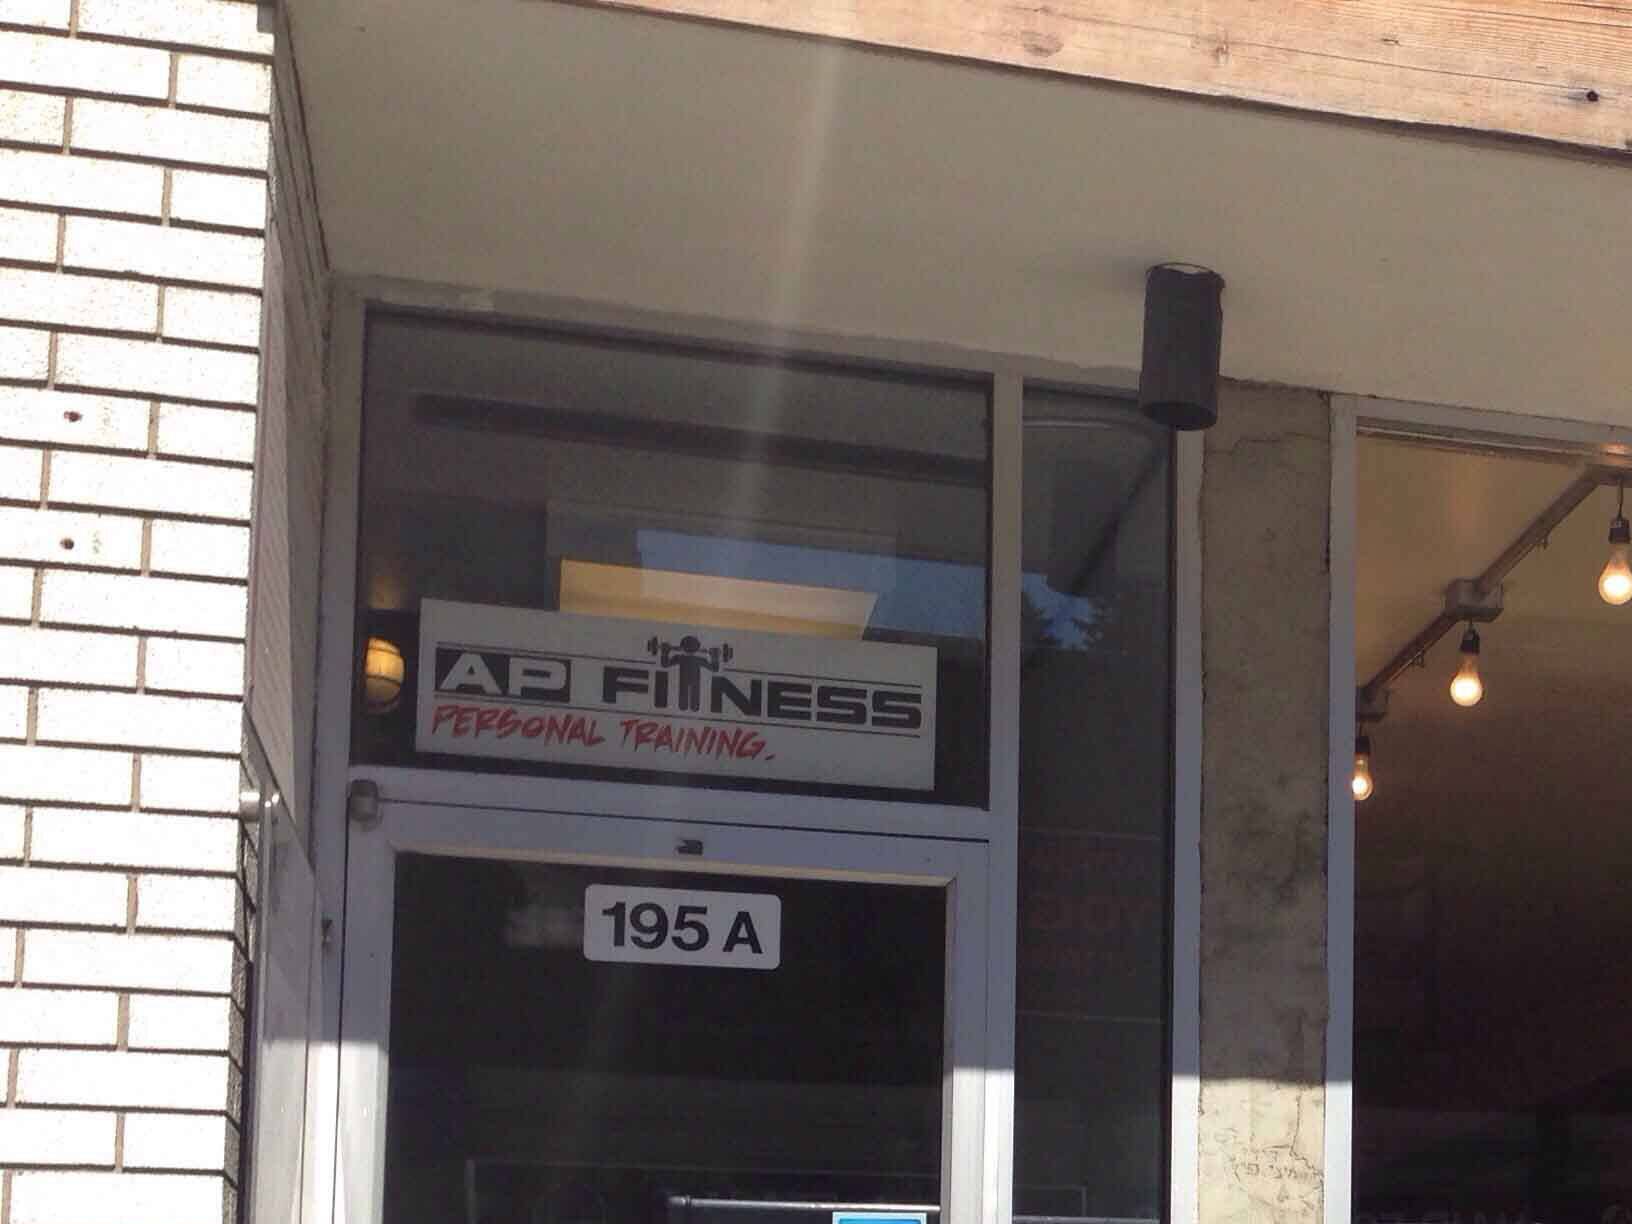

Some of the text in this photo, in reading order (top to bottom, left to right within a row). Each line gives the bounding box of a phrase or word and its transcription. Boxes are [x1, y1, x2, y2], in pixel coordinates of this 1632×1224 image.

[438, 651, 569, 700] AP
[432, 704, 605, 747] PERSONAL
[602, 901, 763, 954] 195 A
